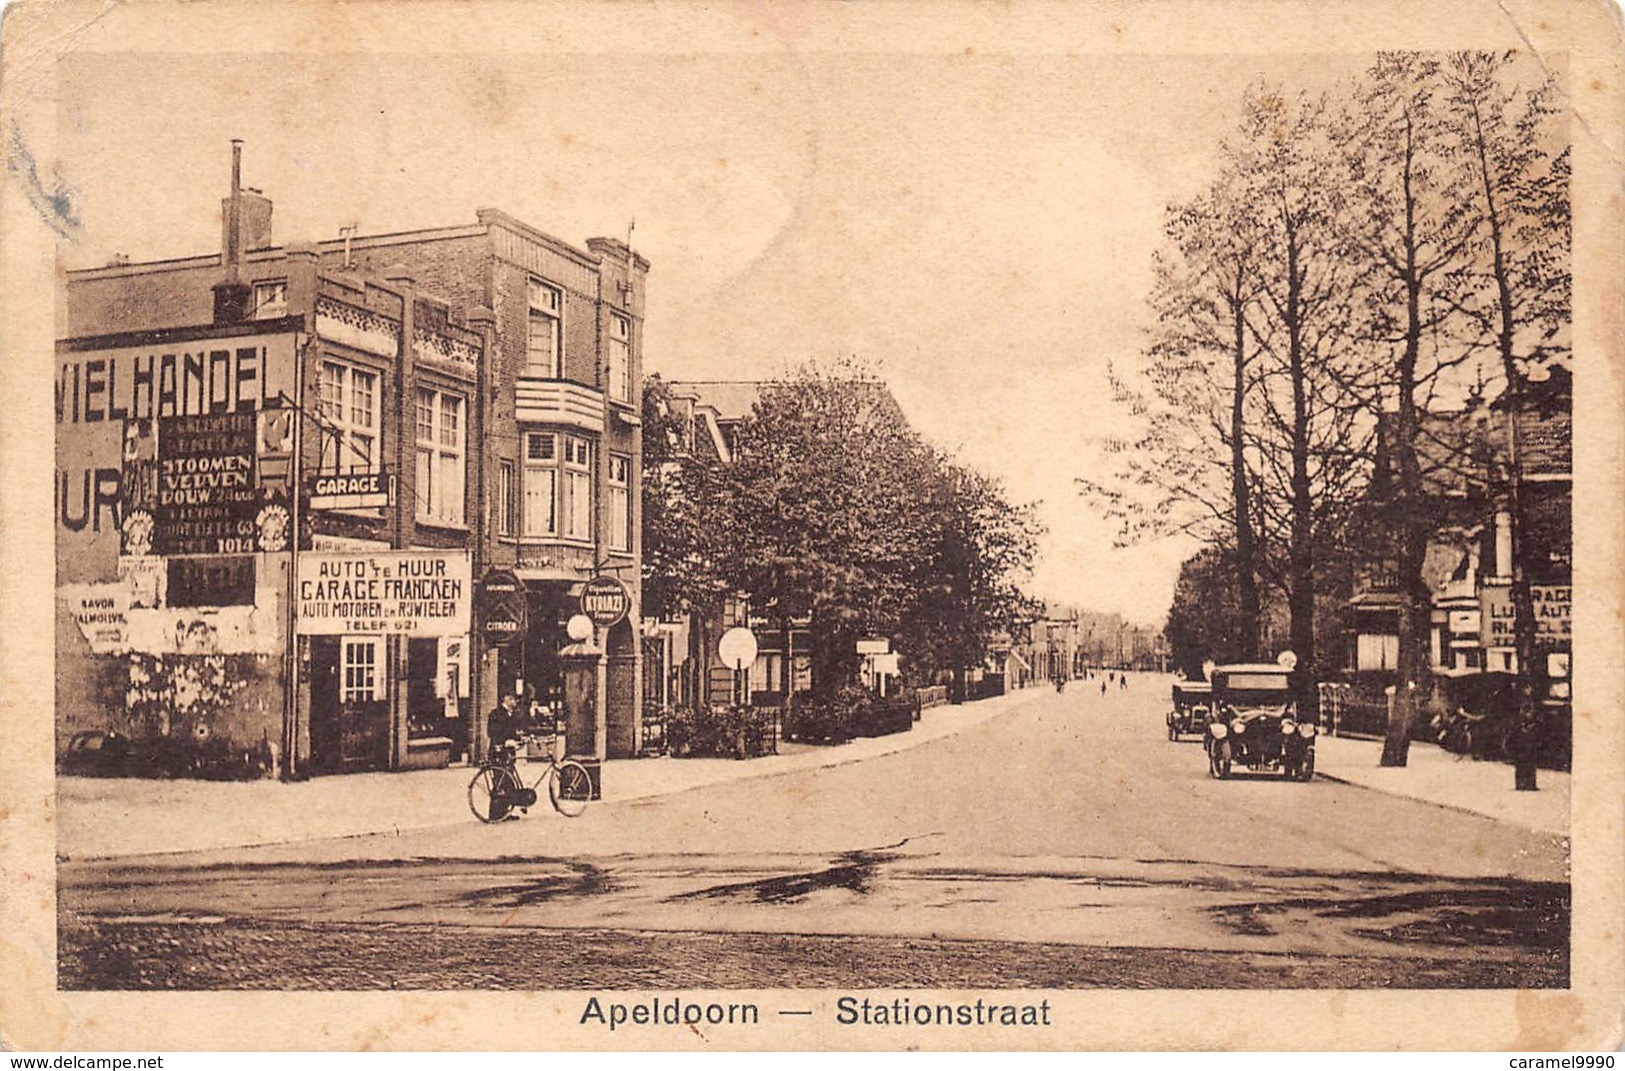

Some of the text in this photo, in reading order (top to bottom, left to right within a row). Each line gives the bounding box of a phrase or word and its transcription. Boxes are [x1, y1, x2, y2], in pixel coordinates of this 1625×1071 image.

[316, 476, 380, 495] GARAGE
[55, 467, 124, 533] UR
[216, 538, 255, 554] 1014
[373, 567, 392, 578] TE
[398, 560, 447, 577] HUUR
[301, 579, 462, 600] GARAGE FRANCKEN
[302, 602, 329, 618] AUTO
[331, 601, 382, 618] MOTOREN
[394, 620, 418, 631] 621
